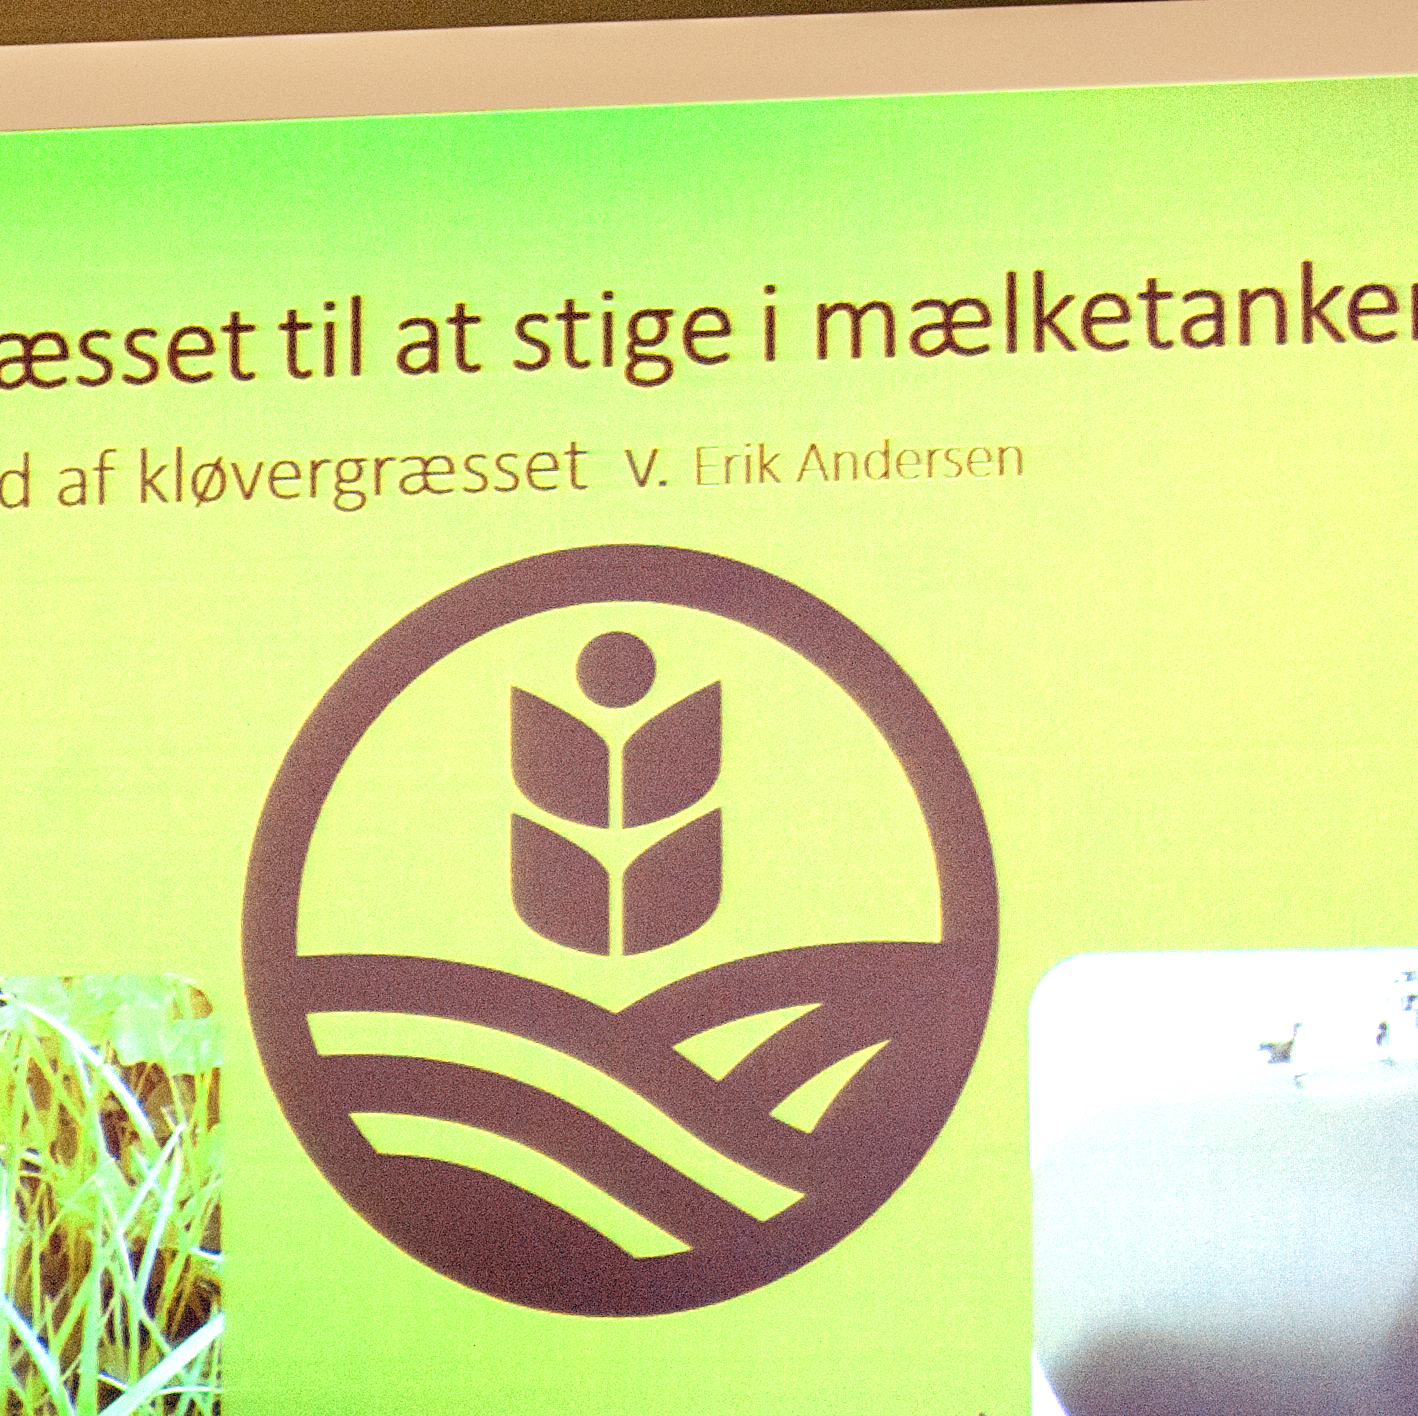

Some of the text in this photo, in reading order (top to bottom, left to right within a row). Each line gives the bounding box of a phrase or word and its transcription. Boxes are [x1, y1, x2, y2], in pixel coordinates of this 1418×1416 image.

[277, 294, 364, 382] til
[395, 301, 483, 377] at
[512, 289, 734, 389] stige
[762, 283, 779, 363] i
[56, 447, 117, 508] af
[139, 441, 588, 513] kløvergræsset
[624, 447, 666, 489] v.
[693, 442, 782, 485] Erik
[796, 439, 1025, 482] Andersen
